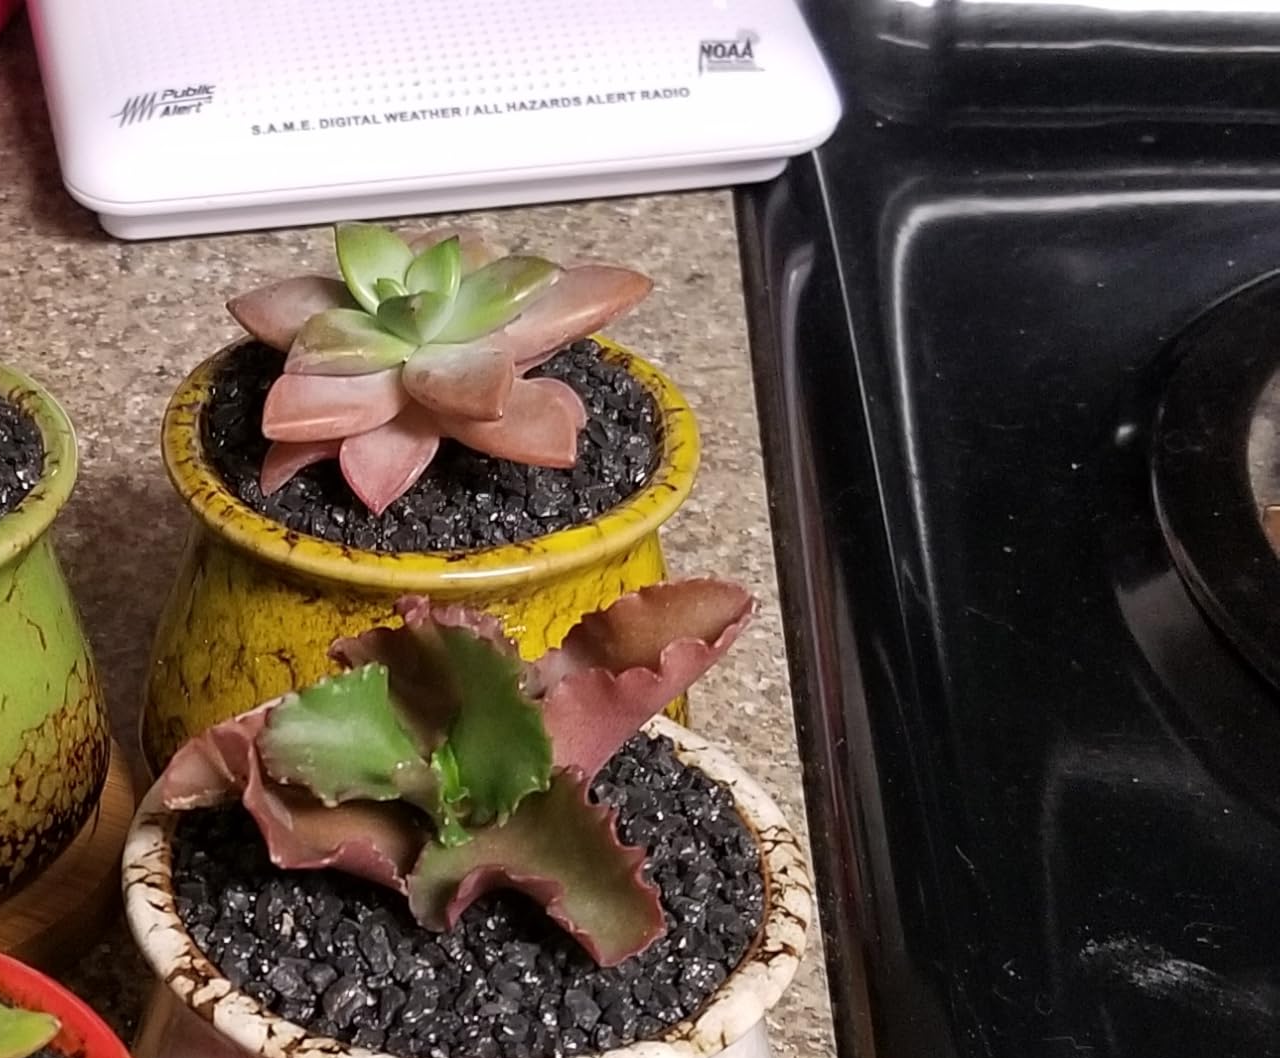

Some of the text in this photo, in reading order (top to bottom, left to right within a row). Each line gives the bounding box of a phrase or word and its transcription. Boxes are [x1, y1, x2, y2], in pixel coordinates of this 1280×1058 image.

[161, 85, 216, 101] Public
[160, 101, 203, 118] Alert
[251, 119, 316, 136] S.A.M.E.
[319, 114, 382, 130] DIGITAL
[384, 106, 462, 124] WEATHER
[473, 104, 504, 116] ALL
[506, 96, 582, 113] HAZARDS
[585, 91, 637, 106] ALERT
[640, 87, 691, 101] RADIO
